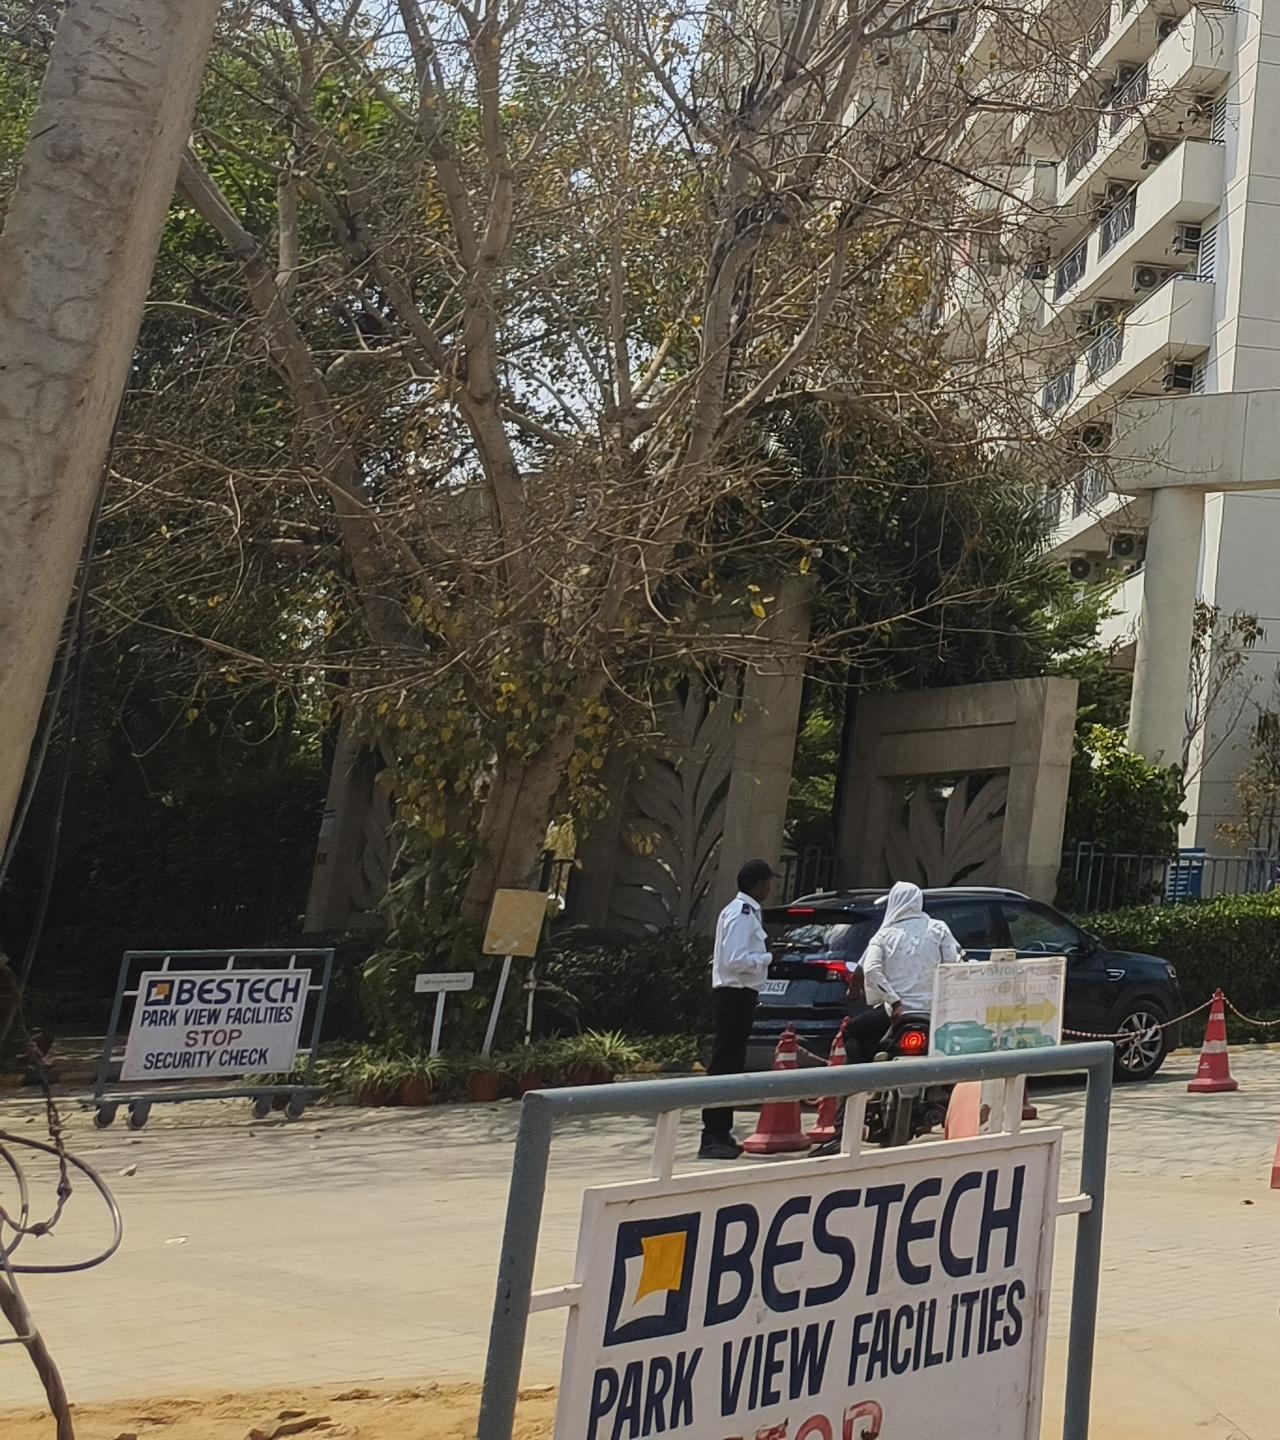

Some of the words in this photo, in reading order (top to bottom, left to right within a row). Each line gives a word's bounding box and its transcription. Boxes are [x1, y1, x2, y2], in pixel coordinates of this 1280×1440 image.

[175, 977, 302, 1006] BESTECH
[140, 1009, 178, 1027] PARK
[183, 1007, 223, 1026] VIEW
[225, 1006, 294, 1024] FACILITIES
[184, 1028, 243, 1048] STOP
[143, 1050, 216, 1070] SECURITY
[218, 1047, 270, 1067] CHECK
[703, 1165, 1026, 1328] BESTECH
[586, 1346, 704, 1440] PARK
[720, 1320, 836, 1417] VIEW
[847, 1279, 1026, 1388] FACILITIES
